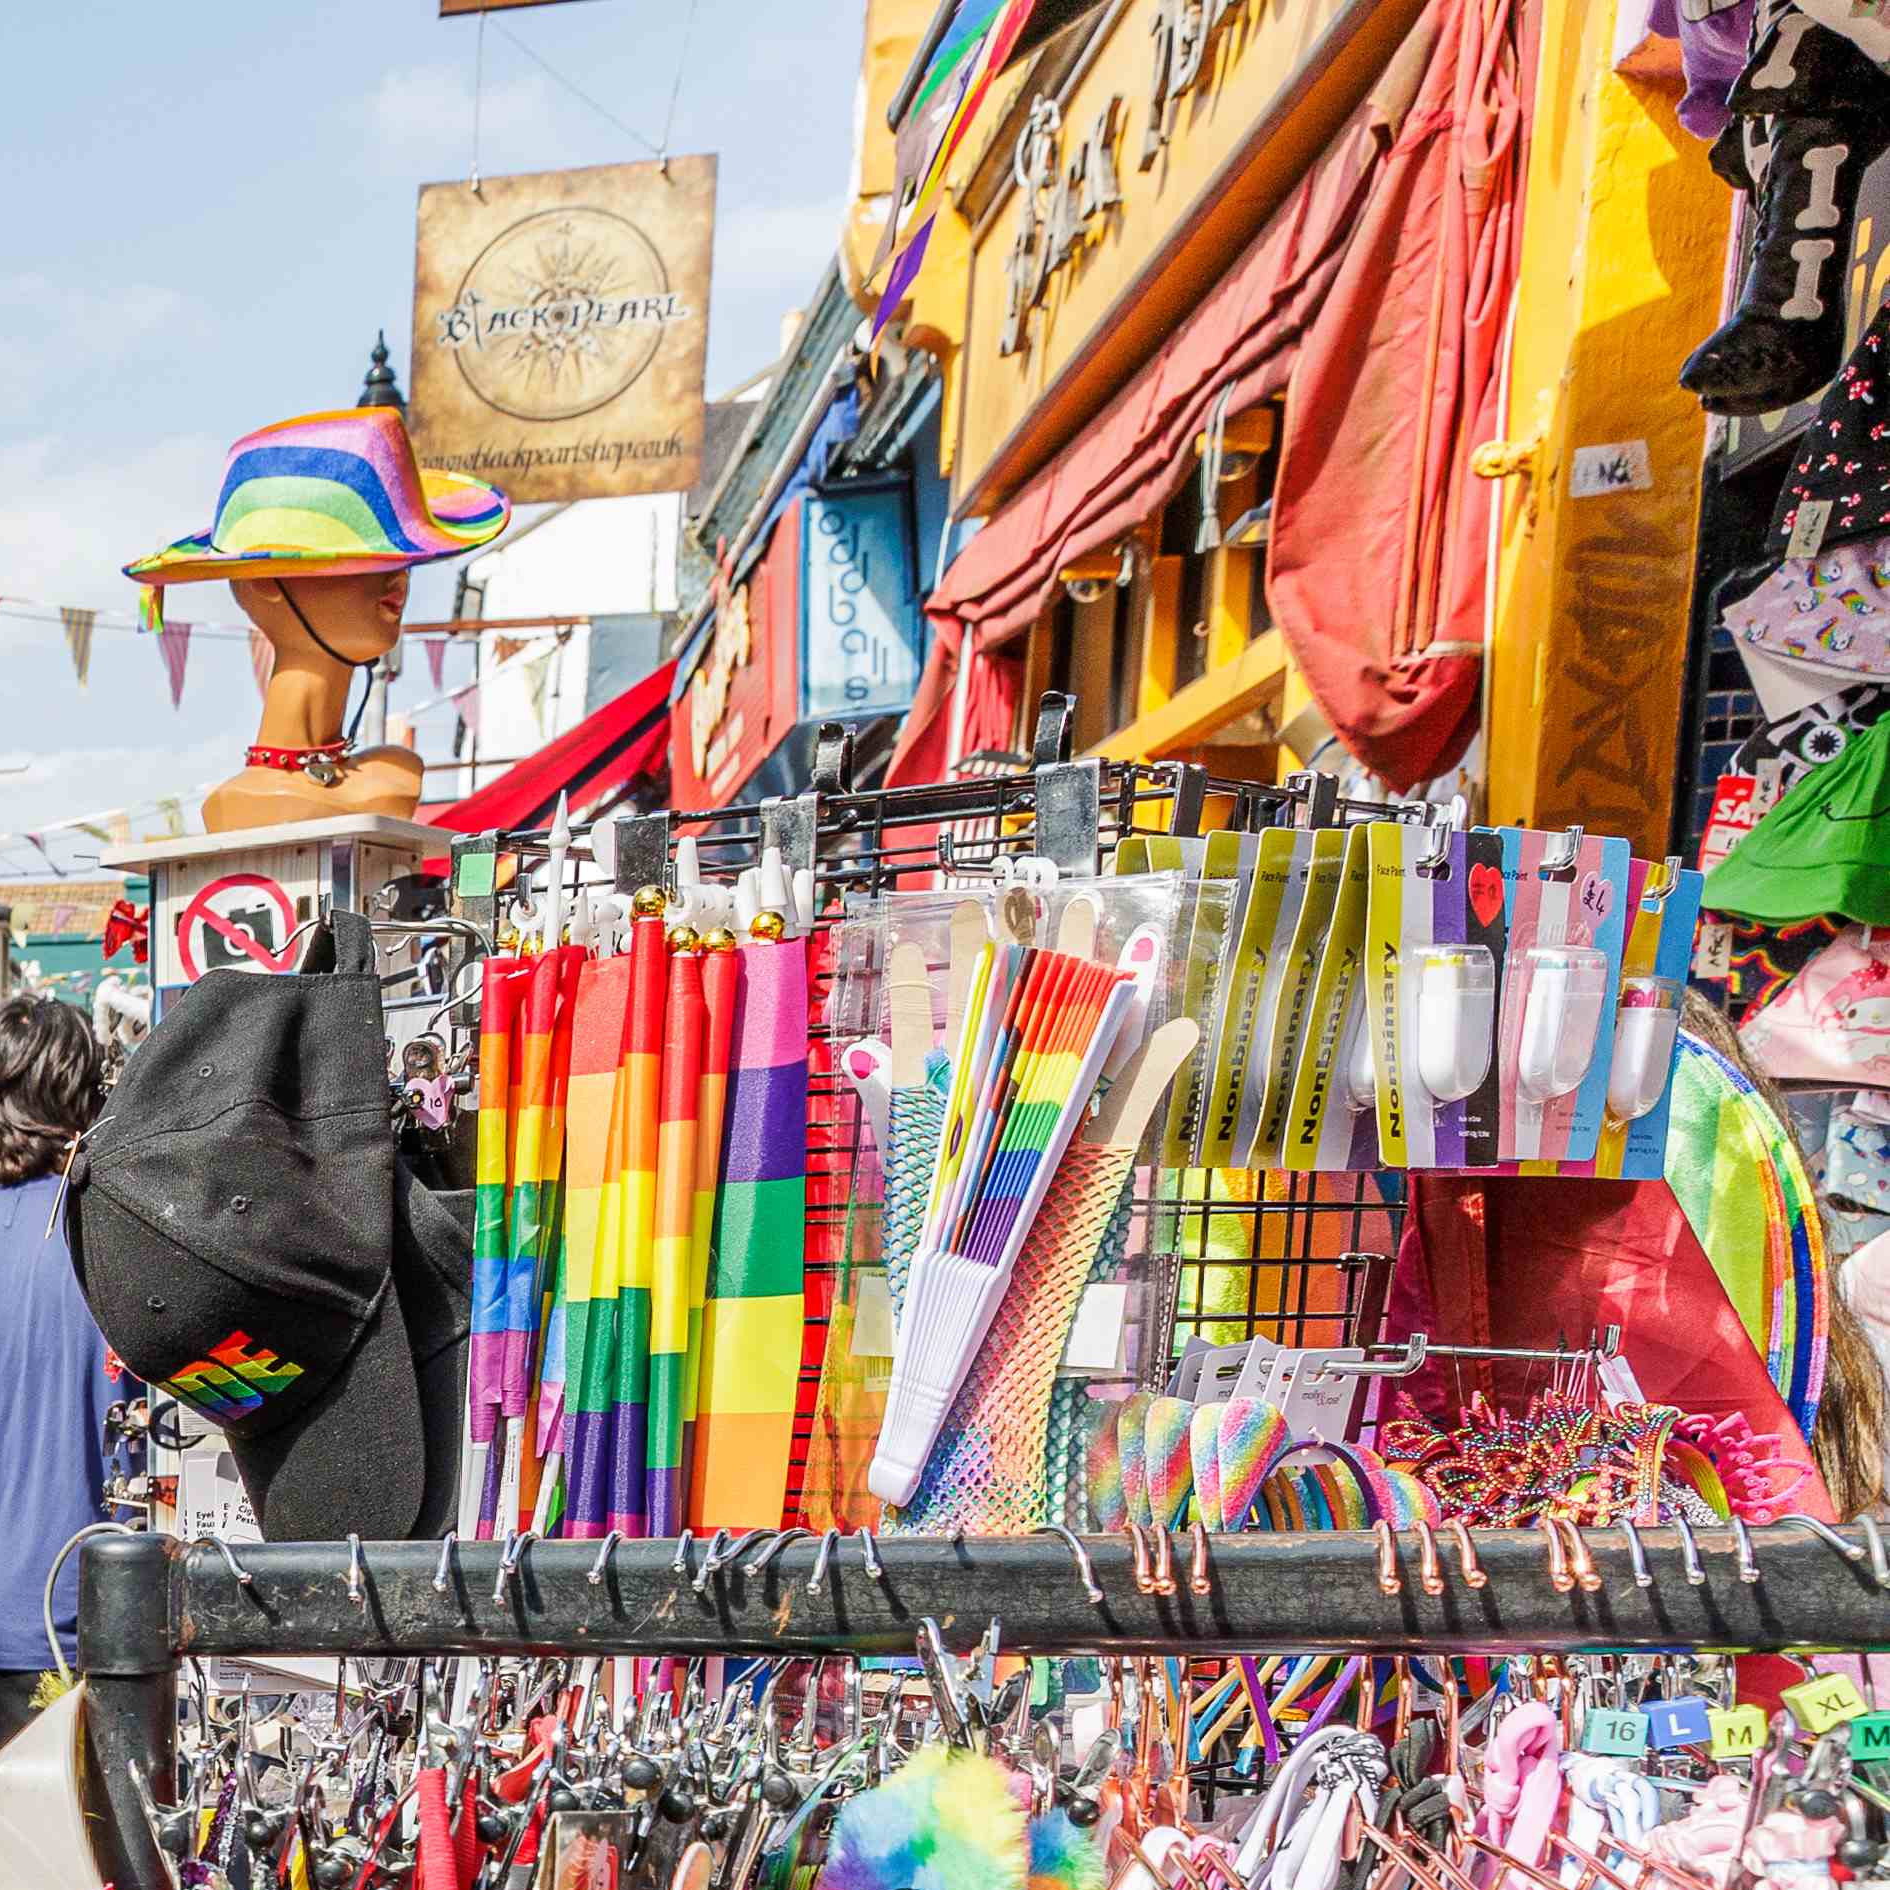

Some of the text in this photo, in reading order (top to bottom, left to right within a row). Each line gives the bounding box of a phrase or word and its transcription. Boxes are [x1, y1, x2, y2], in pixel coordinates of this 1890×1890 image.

[1217, 945, 1267, 1142] Nonbinary
[1266, 946, 1316, 1143] Nonbinary
[1300, 946, 1358, 1145] Nonbinary
[1382, 941, 1401, 1138] Nonbinary
[1815, 1691, 1856, 1717] XL
[1605, 1720, 1637, 1742] 16
[1668, 1713, 1692, 1737] L
[1727, 1725, 1753, 1747] M
[1864, 1727, 1890, 1747] M
